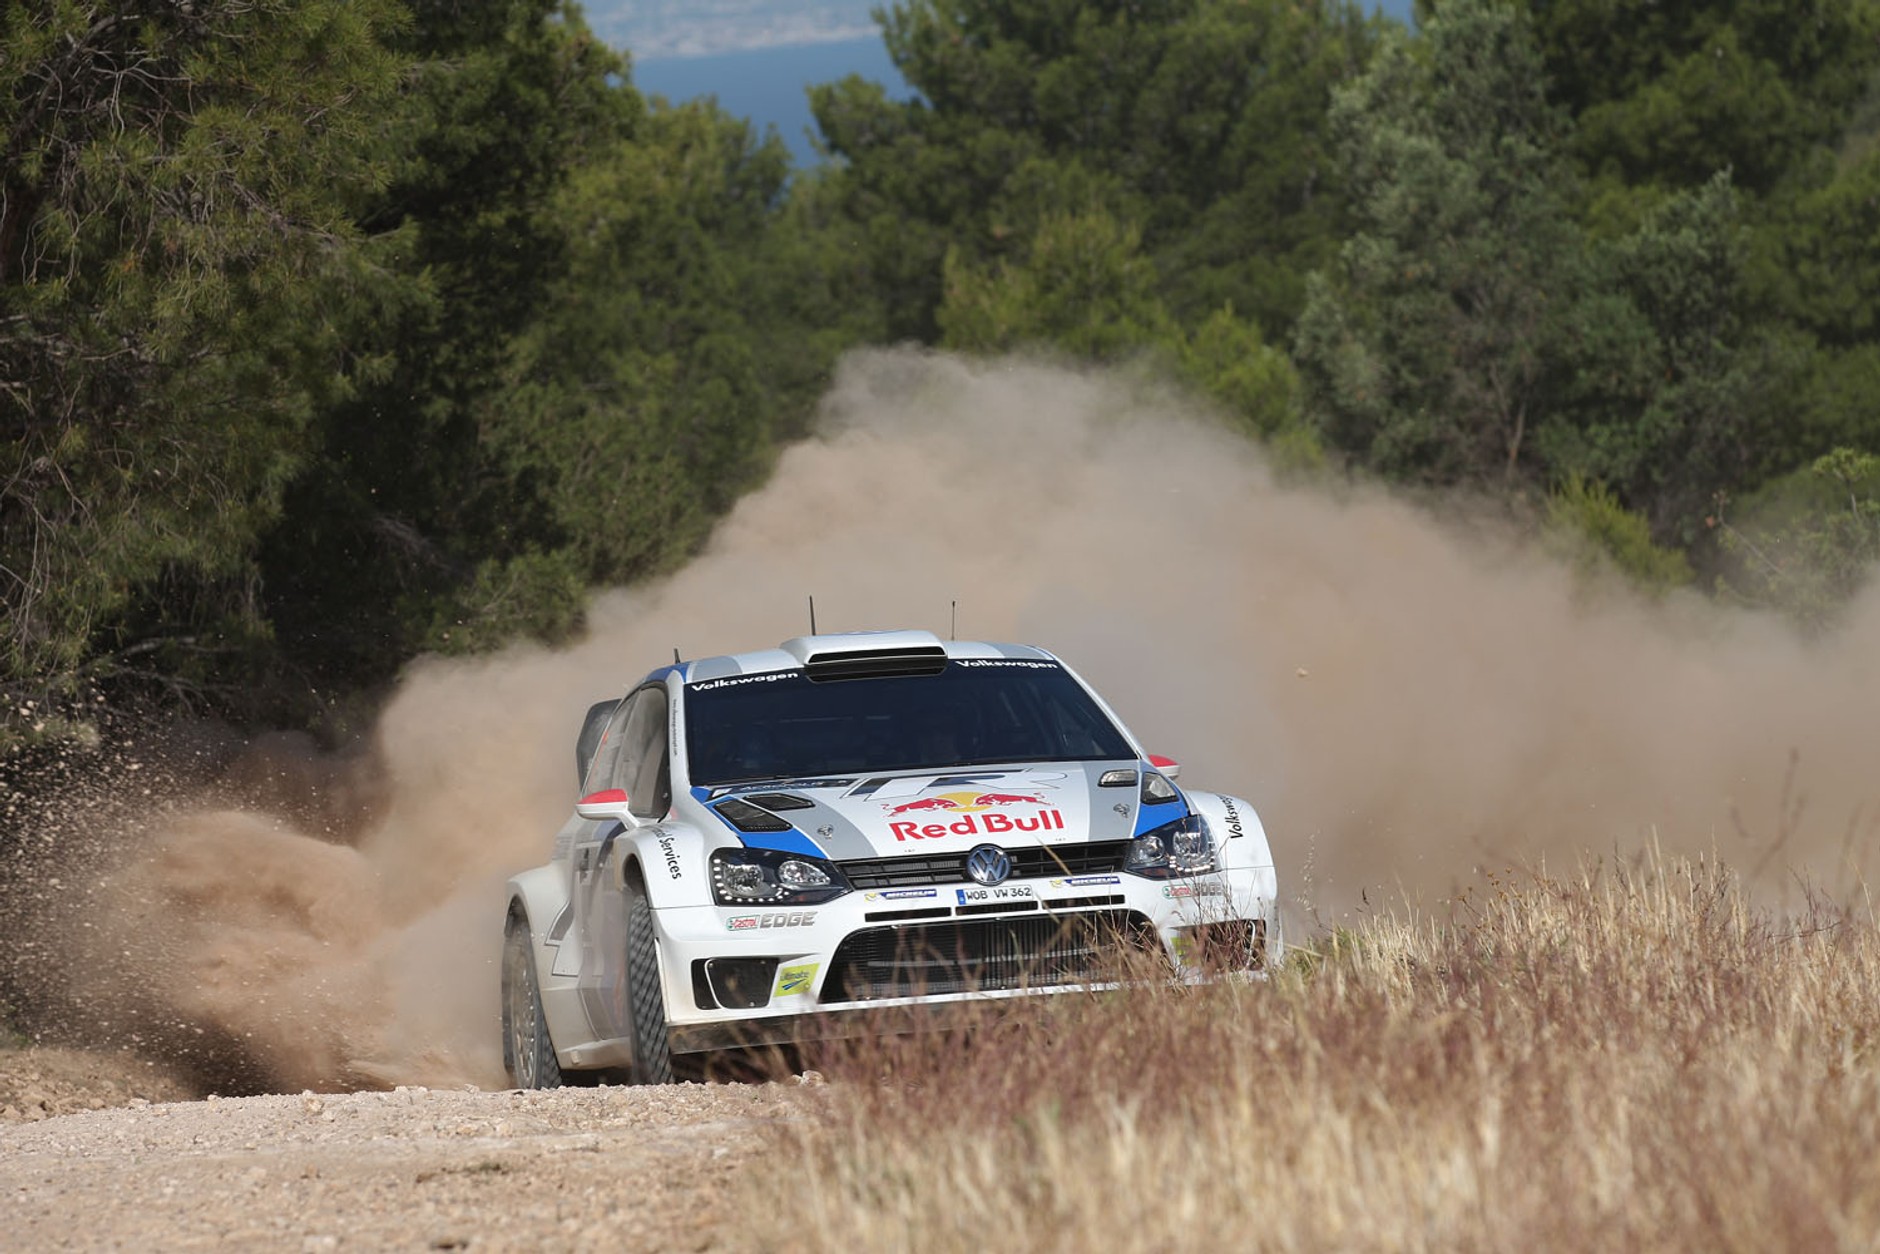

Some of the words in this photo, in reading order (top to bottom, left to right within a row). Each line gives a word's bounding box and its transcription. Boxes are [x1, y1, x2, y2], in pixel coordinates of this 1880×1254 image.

[955, 660, 1058, 669] Volkswagen
[691, 672, 799, 691] Volkswagen
[889, 815, 978, 841] Red
[981, 810, 1065, 833] Bull
[659, 837, 682, 879] Services
[885, 889, 936, 899] MICHELIN
[966, 889, 988, 899] WOB
[994, 888, 1008, 898] VW
[1011, 887, 1031, 897] 362
[760, 911, 818, 929] EDGE
